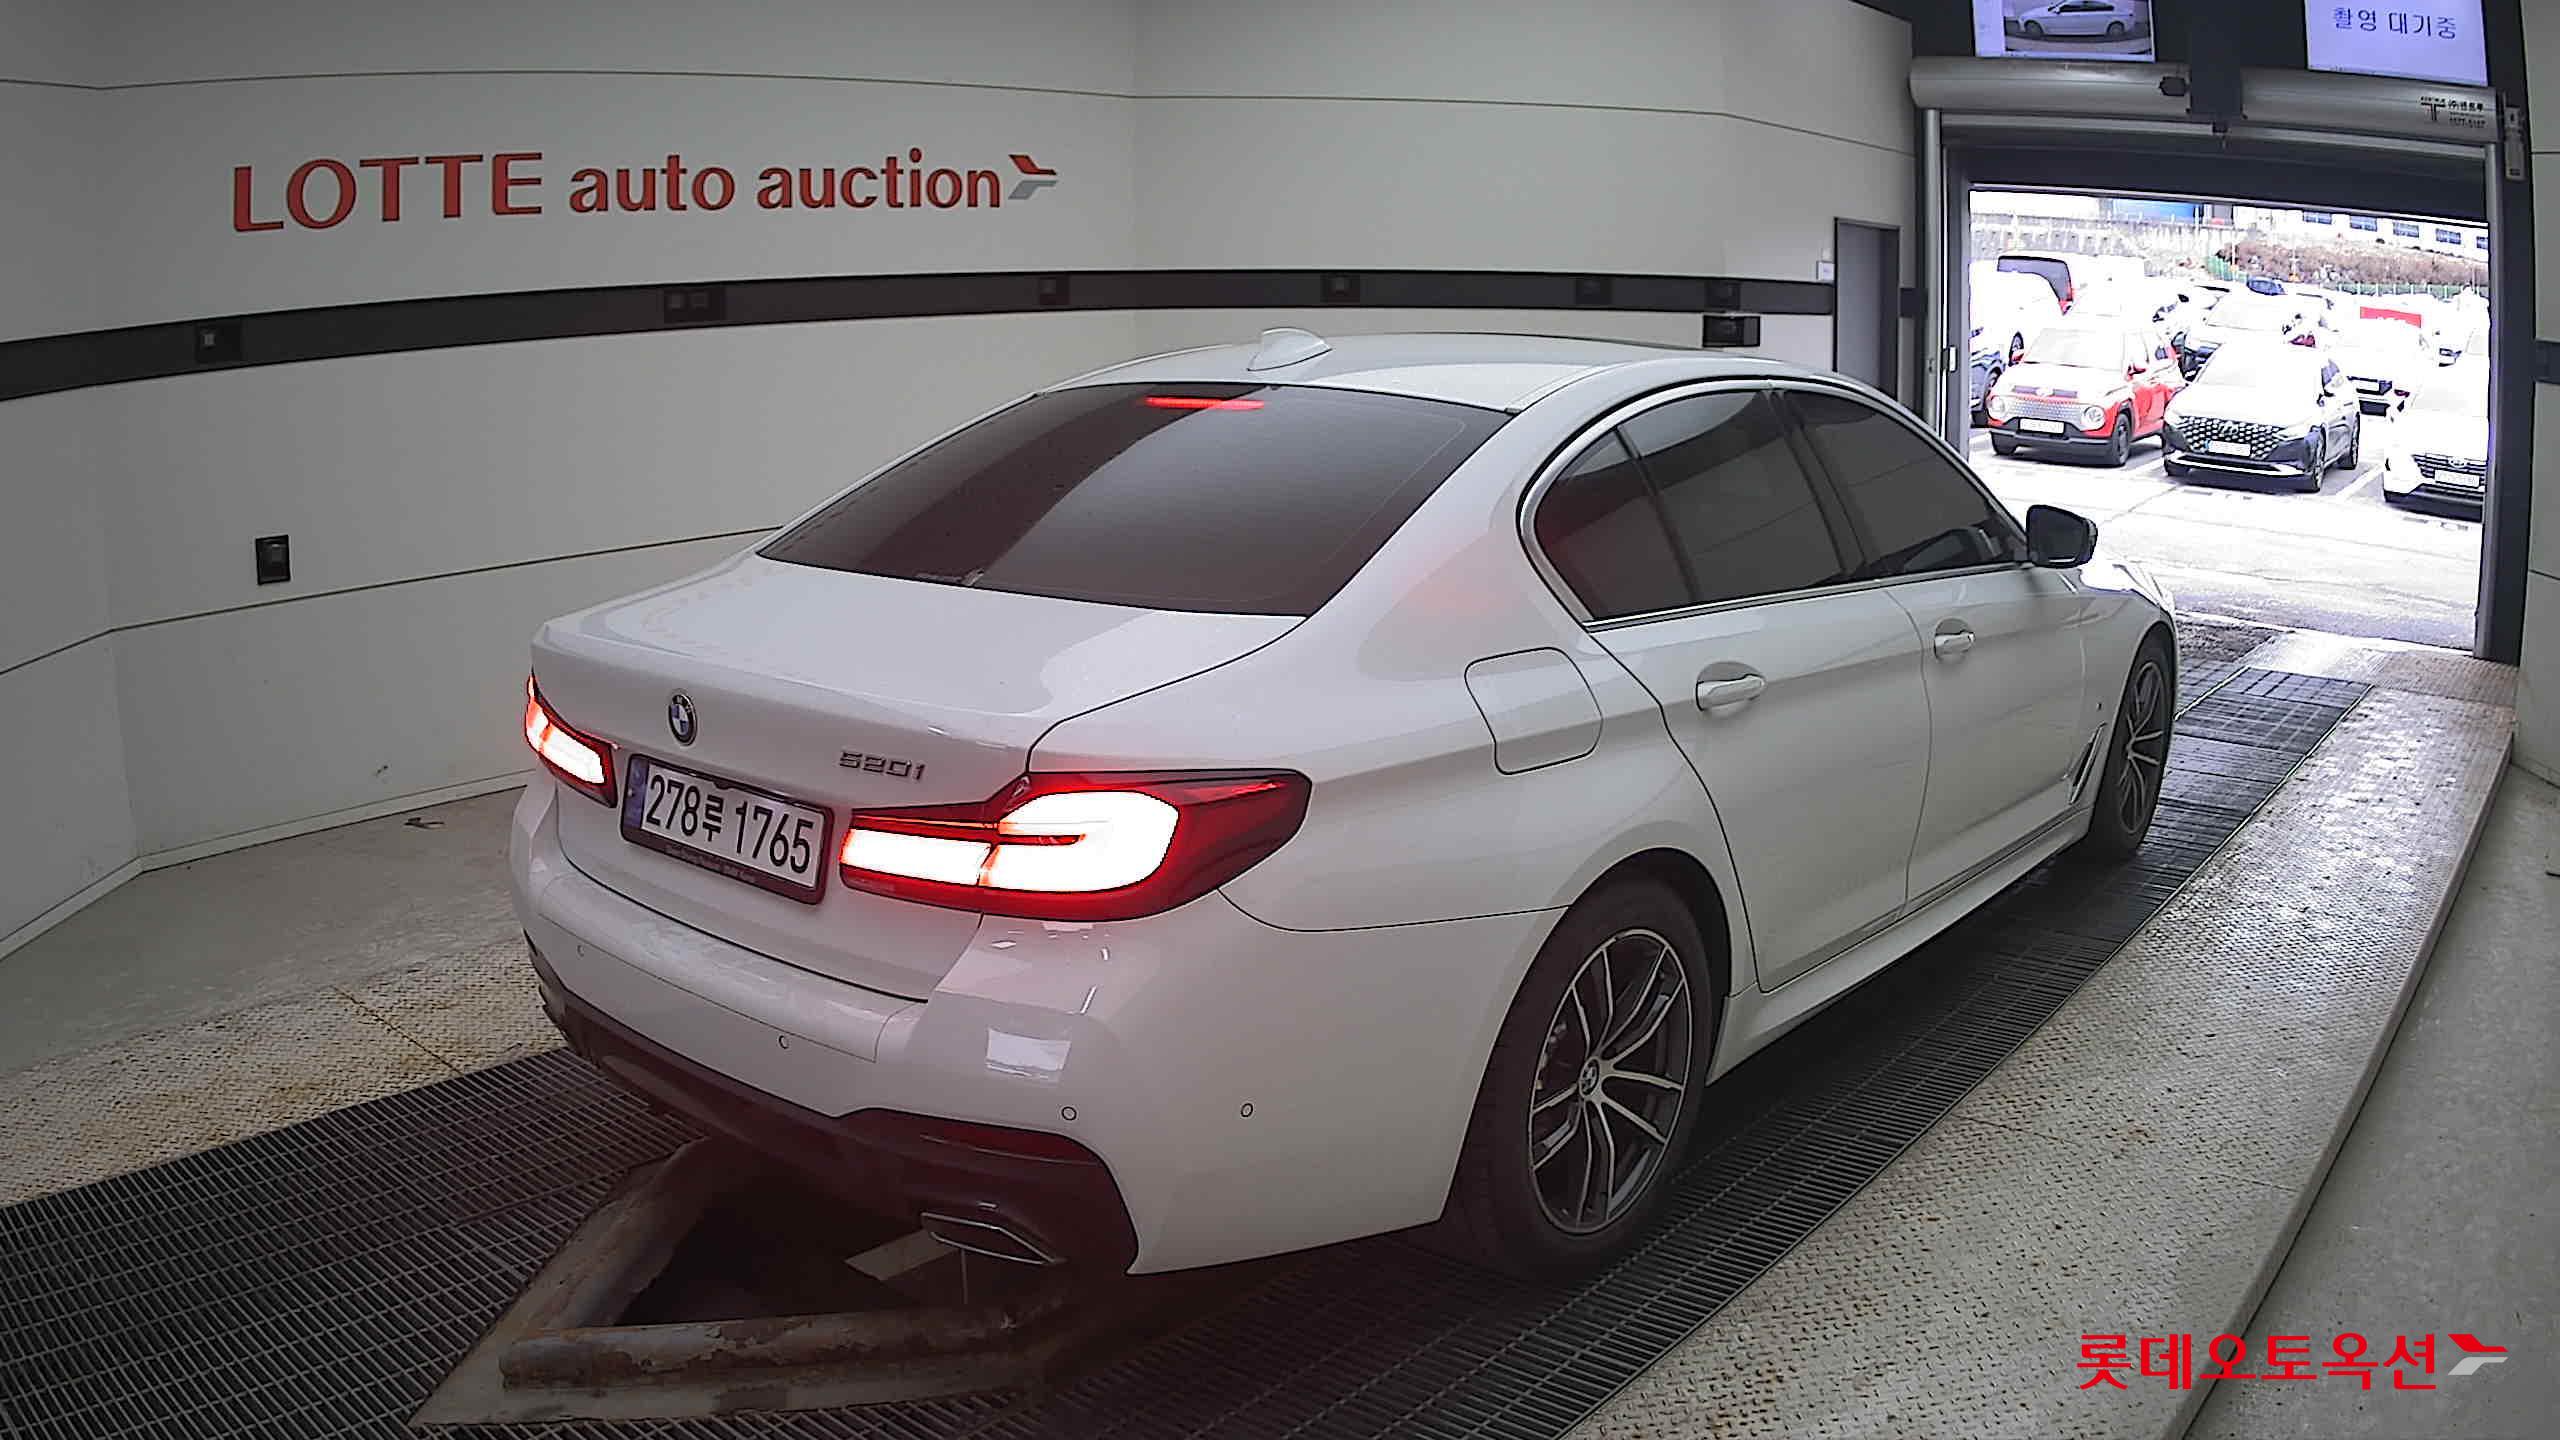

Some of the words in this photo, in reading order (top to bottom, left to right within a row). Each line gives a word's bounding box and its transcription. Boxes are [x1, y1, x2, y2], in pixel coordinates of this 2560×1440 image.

[2334, 7, 2377, 32] 촬영
[2388, 12, 2456, 40] 대기중
[233, 152, 543, 233] LOTTE
[569, 154, 735, 213] auto
[757, 147, 1002, 210] auction
[645, 774, 724, 842] 278루
[735, 800, 813, 874] 1765
